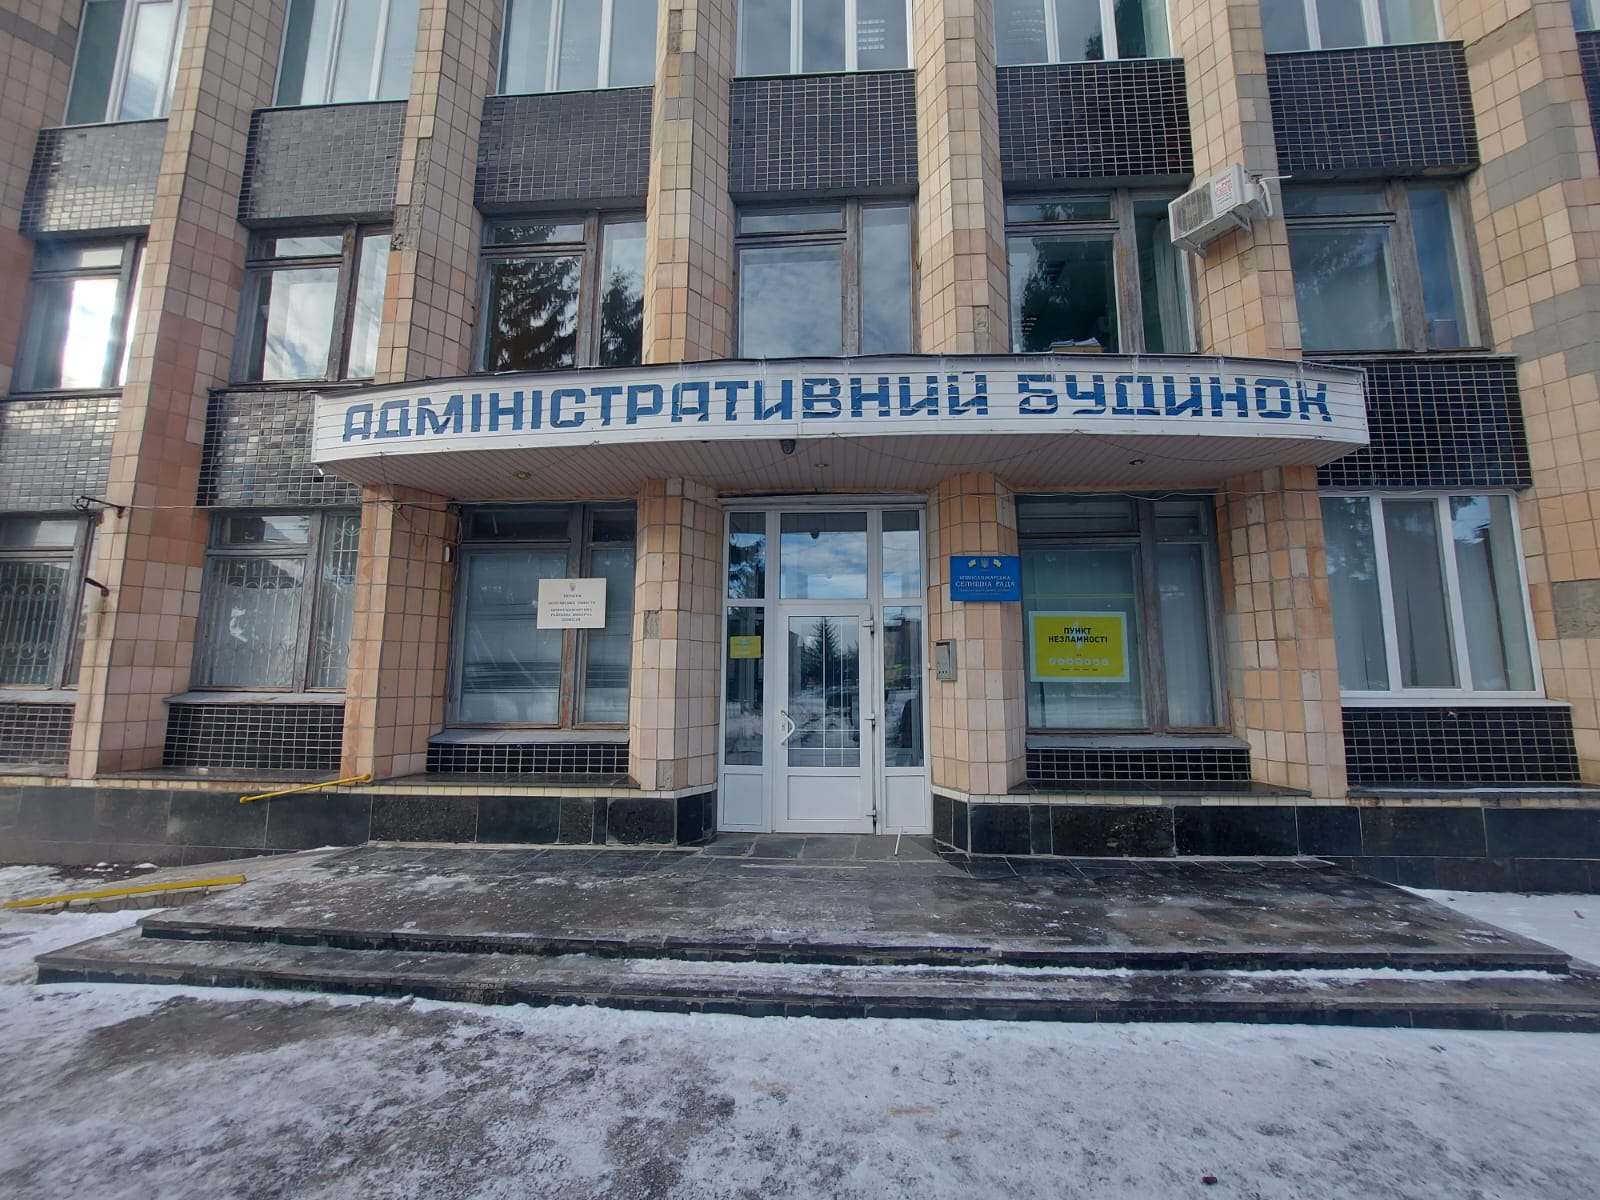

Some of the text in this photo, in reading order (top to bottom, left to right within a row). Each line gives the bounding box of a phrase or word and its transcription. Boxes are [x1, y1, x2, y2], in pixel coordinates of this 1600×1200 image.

[343, 371, 1333, 443] АДМІНІСТРАТИВНИЙ БУДИНОК
[955, 580, 1015, 588] СЕЛИЩНА РАДА
[1063, 627, 1092, 635] ПУНКТ
[1048, 635, 1108, 643] НЕЗЛАМНОСТІ
